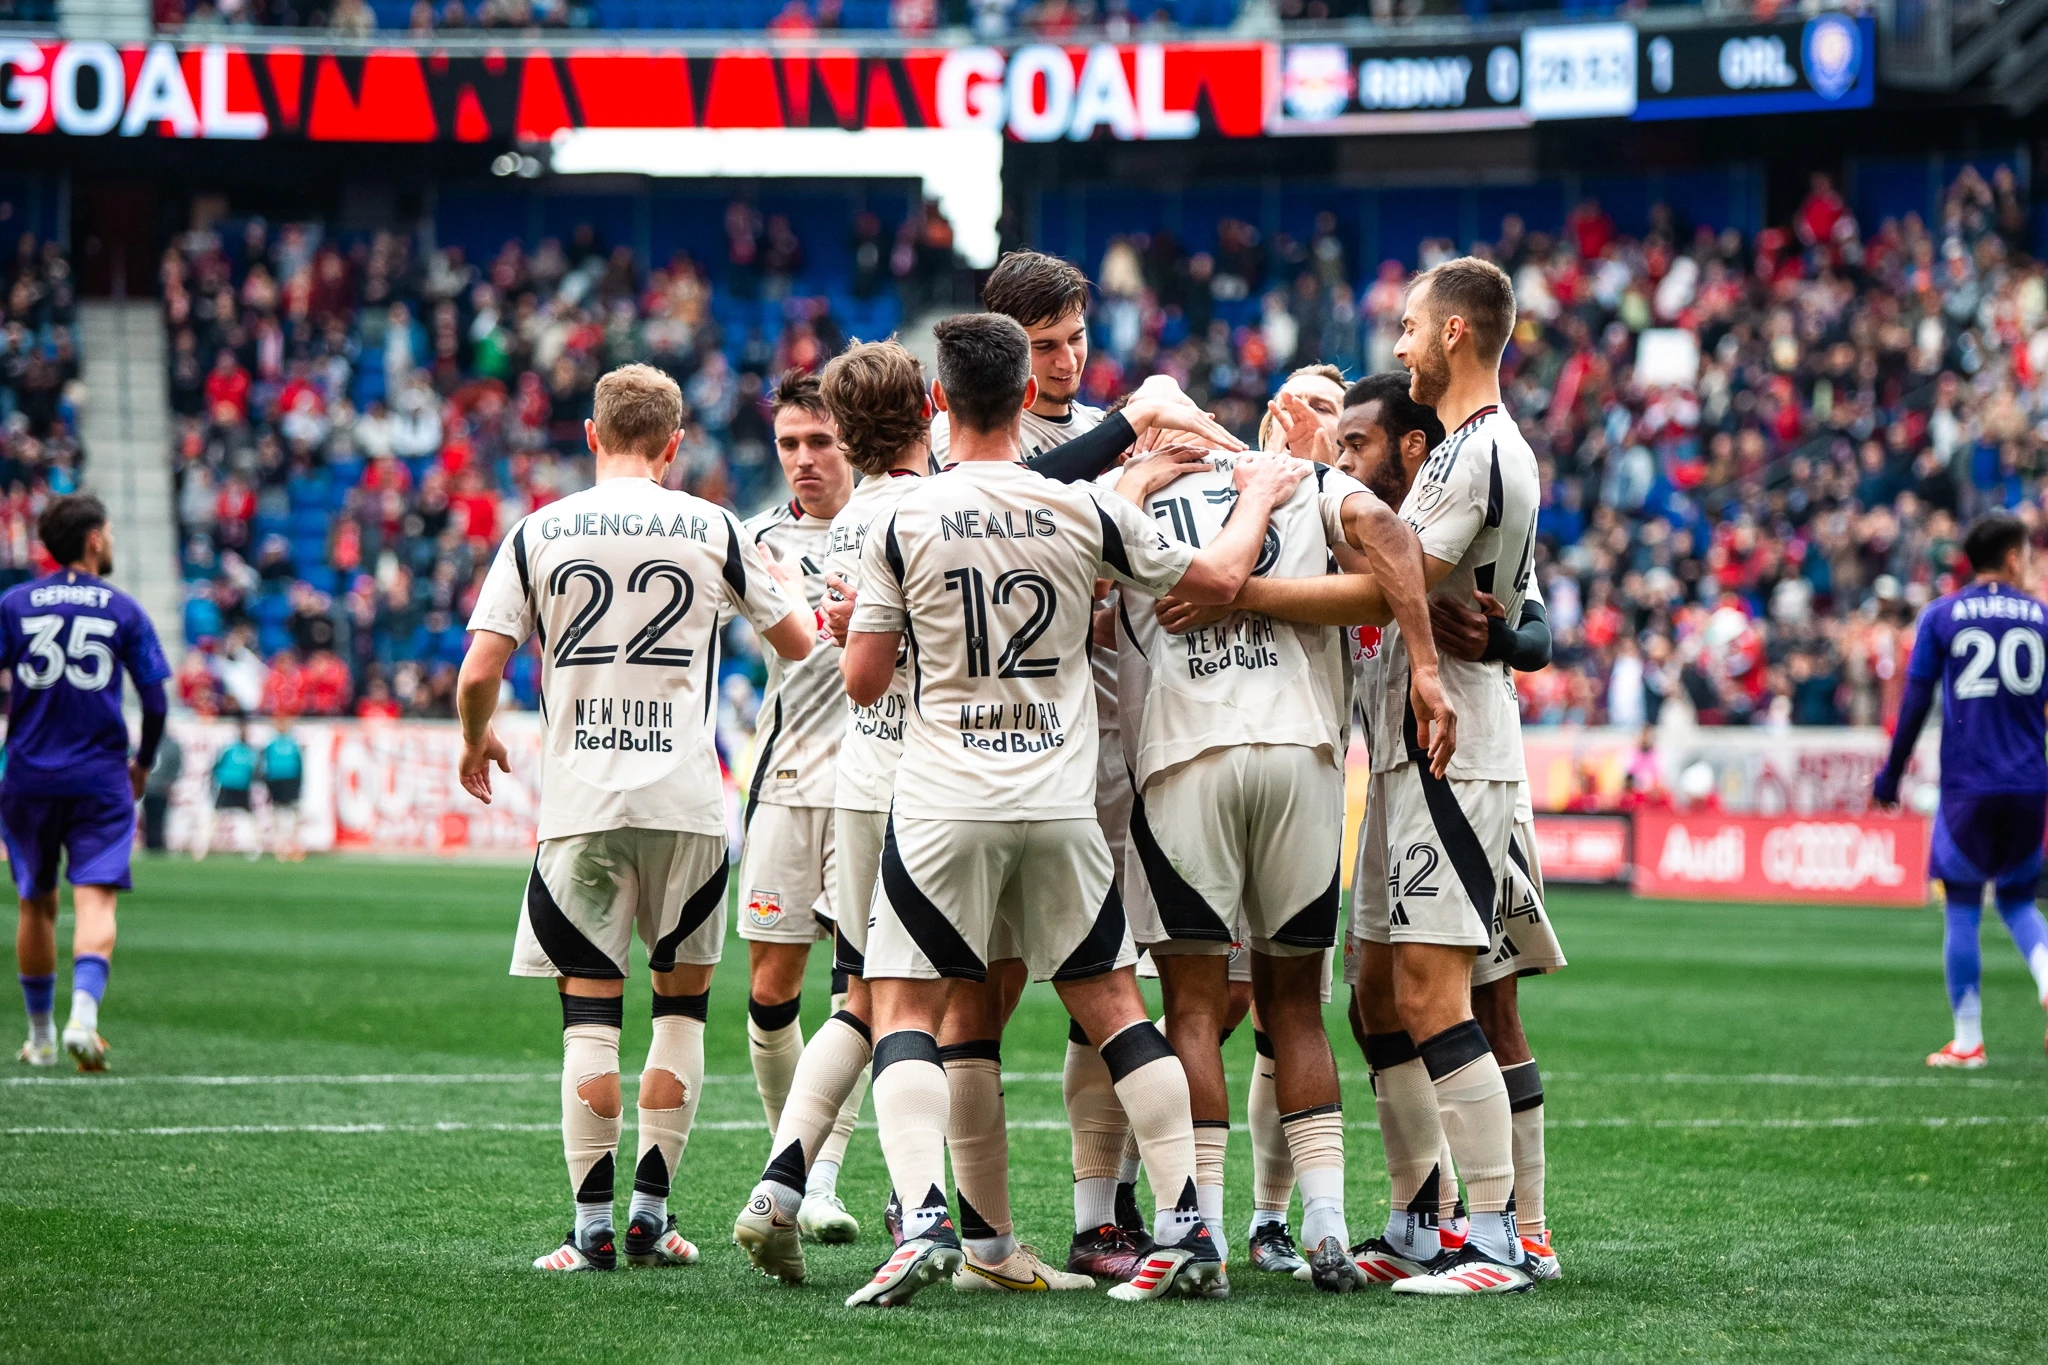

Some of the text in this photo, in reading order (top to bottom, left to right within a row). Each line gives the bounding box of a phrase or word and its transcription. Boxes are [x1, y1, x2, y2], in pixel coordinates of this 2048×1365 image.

[0, 39, 269, 139] GOAL
[935, 44, 1200, 142] GOAL
[1486, 46, 1520, 104] 0
[1648, 35, 1674, 93] 1
[1718, 35, 1797, 89] ORL
[541, 512, 708, 543] GJENGAAR
[940, 508, 1057, 541] NEALIS
[550, 559, 695, 668] 22
[944, 567, 1060, 678] 12
[1186, 616, 1275, 656] NEW YORK
[1951, 595, 2045, 624] ATUESTA
[17, 614, 117, 692] 35
[1951, 626, 2046, 700] 20
[576, 698, 672, 728] NEW YORK
[874, 694, 906, 719] YOR
[960, 702, 1061, 730] NEW YORK
[1659, 824, 1746, 883] Audi
